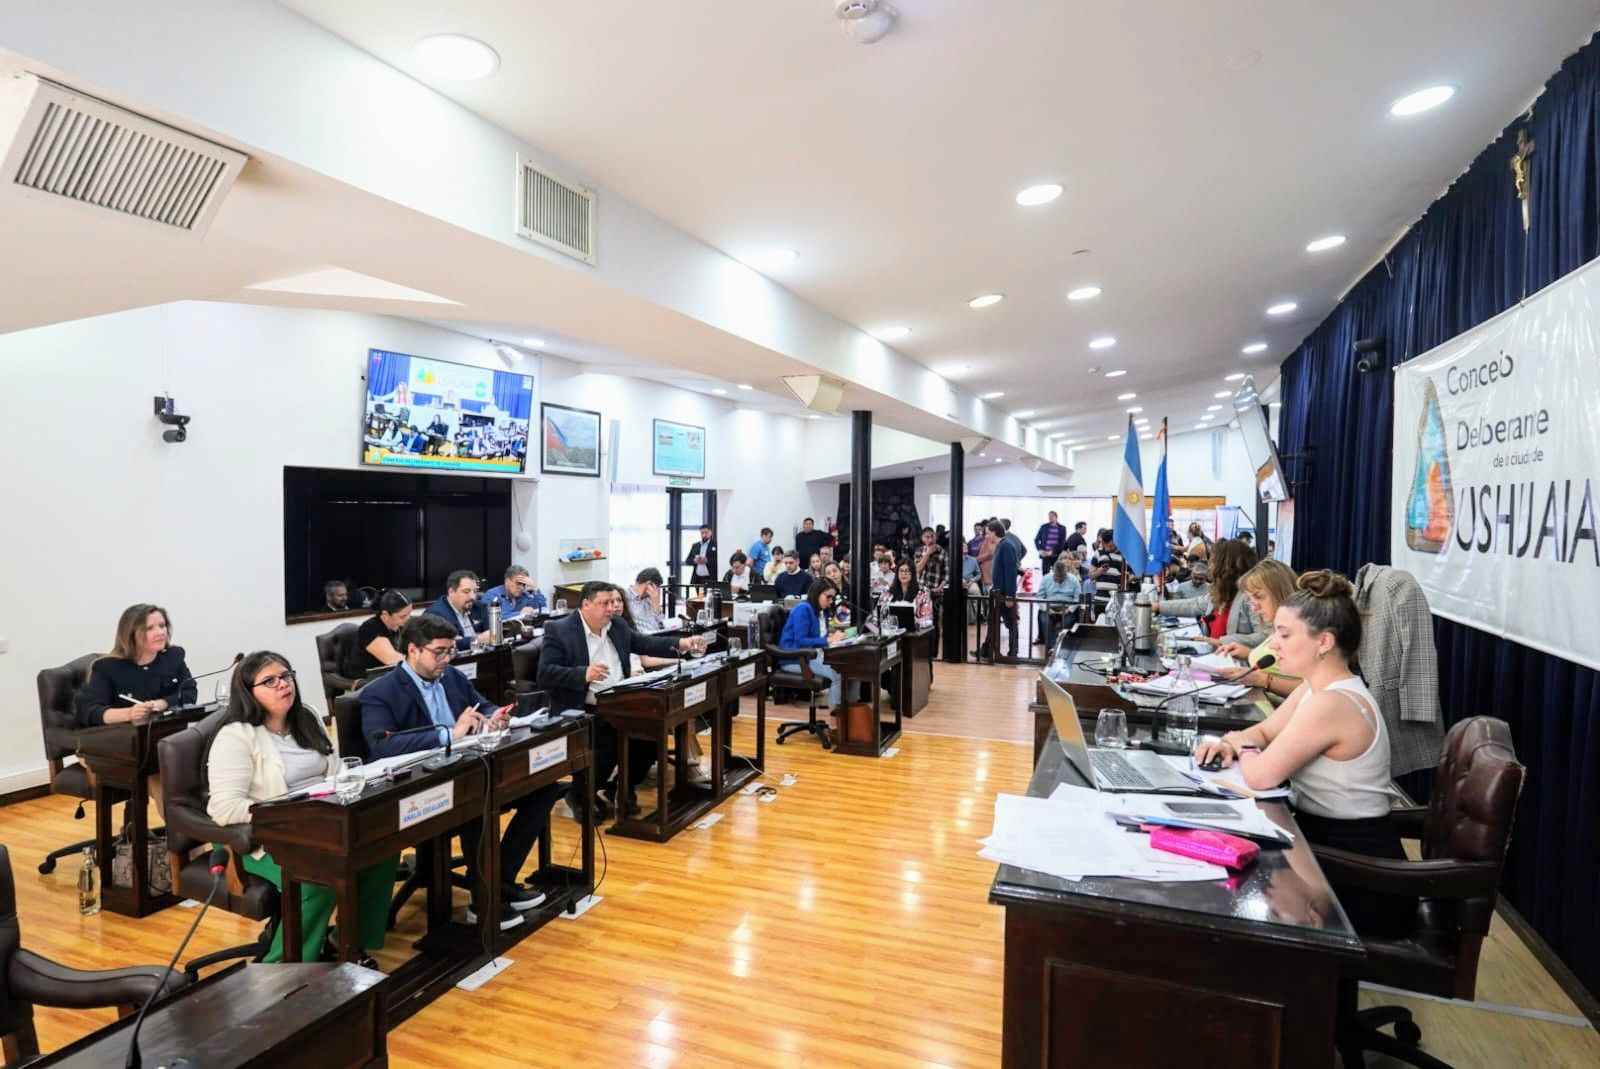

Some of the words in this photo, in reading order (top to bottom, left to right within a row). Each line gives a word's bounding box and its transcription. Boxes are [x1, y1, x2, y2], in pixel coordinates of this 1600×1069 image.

[1456, 408, 1549, 451] Delberane
[1493, 452, 1504, 468] de
[1532, 446, 1544, 463] de
[1456, 477, 1600, 568] USHUAIA
